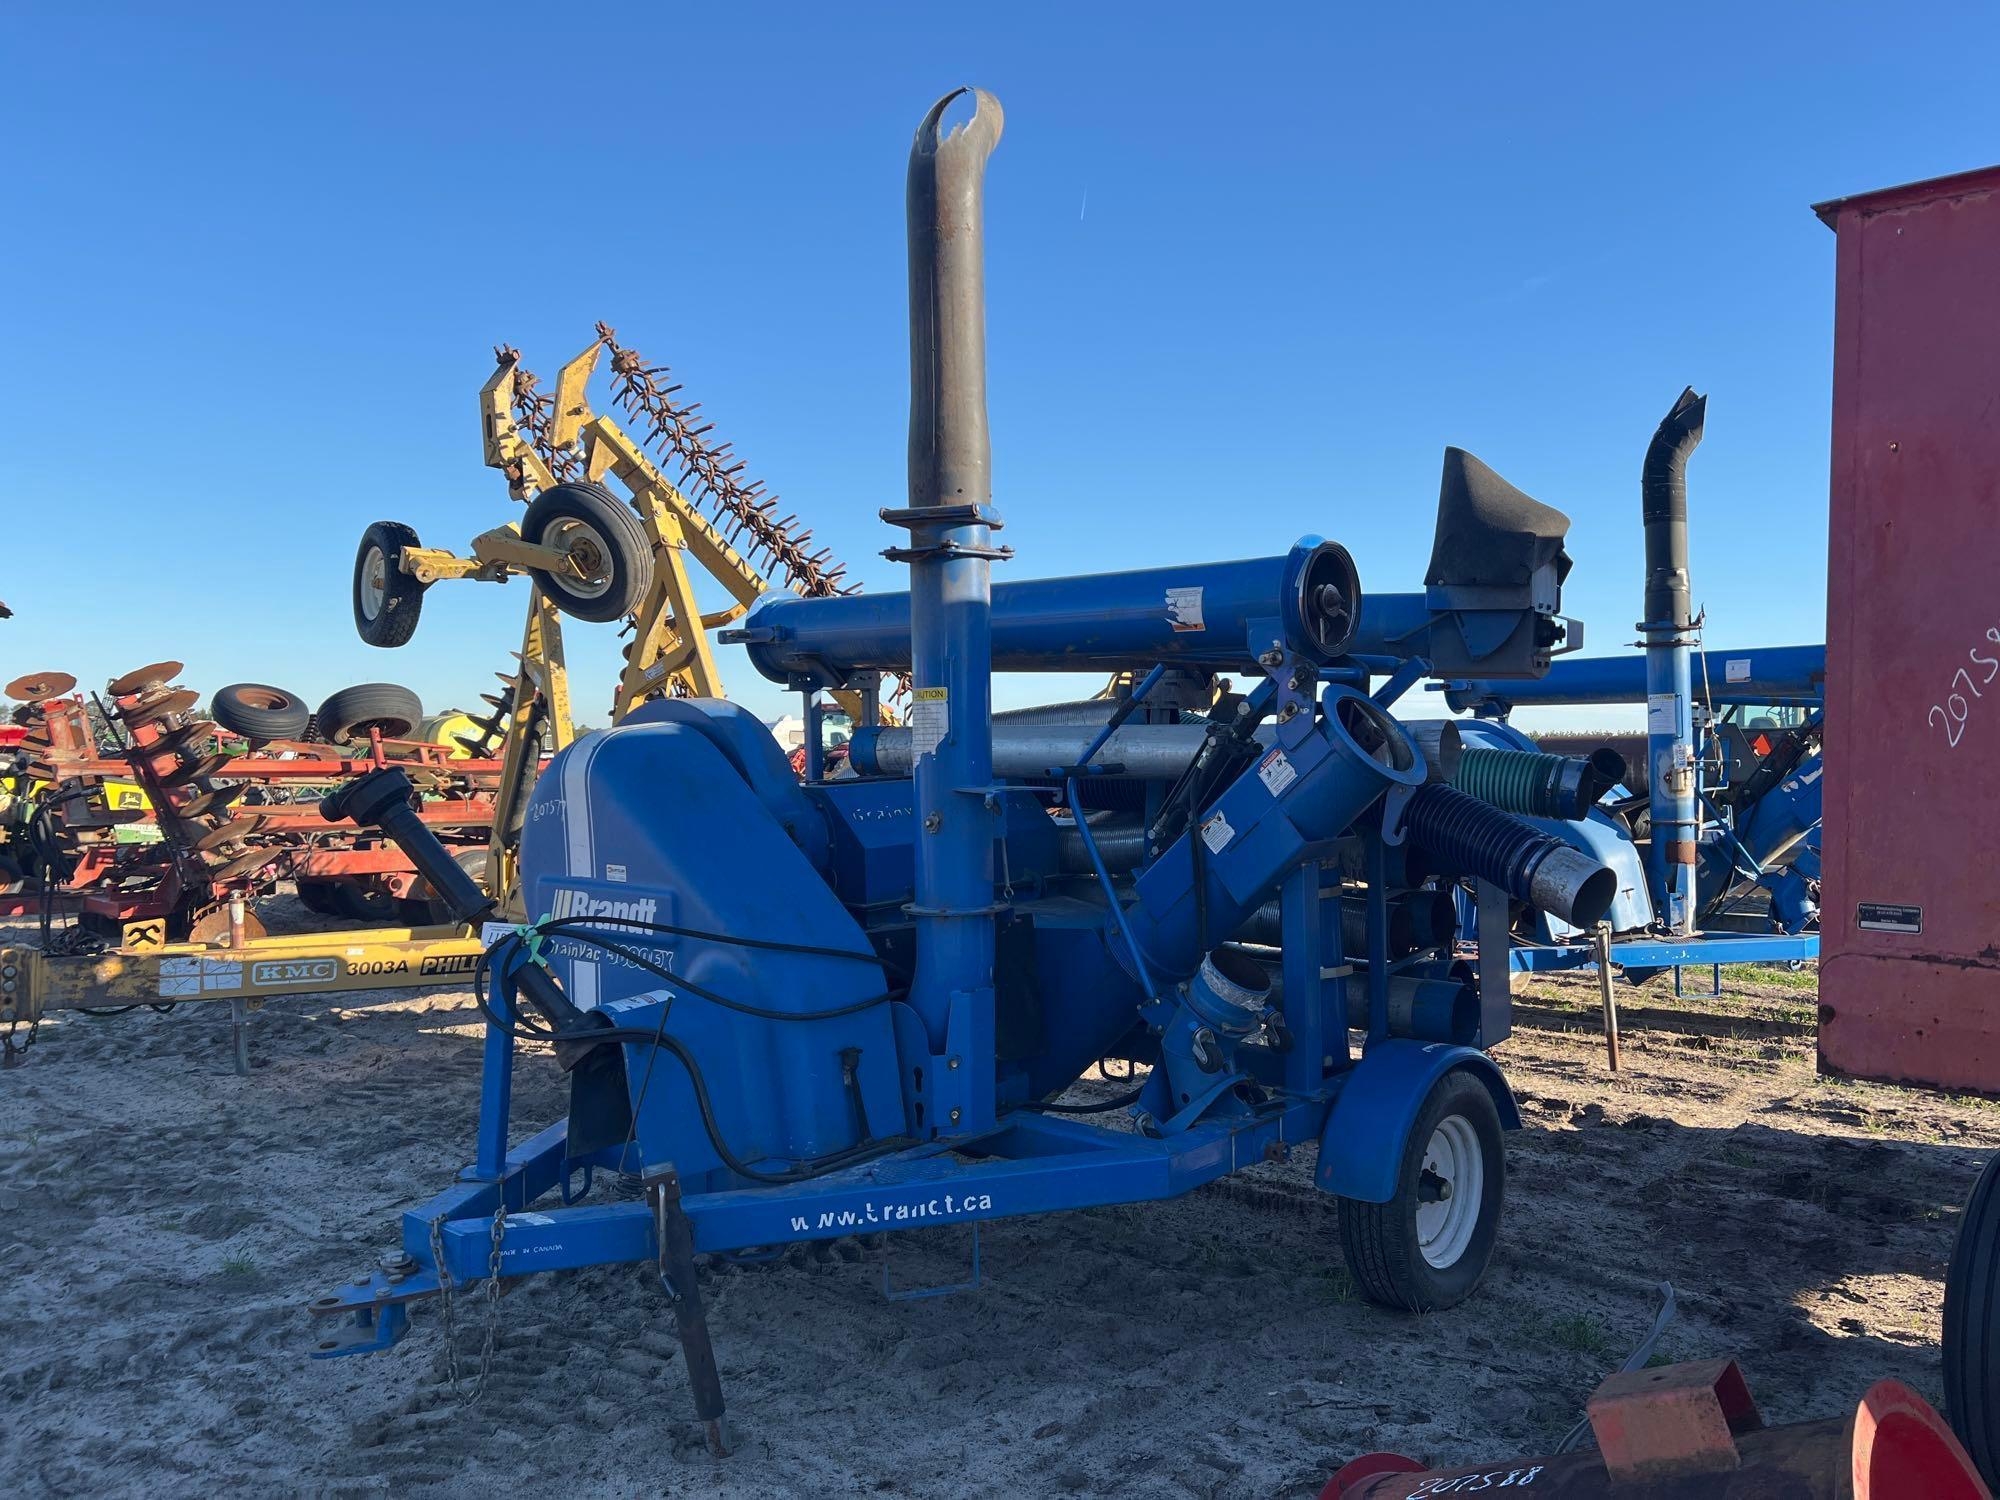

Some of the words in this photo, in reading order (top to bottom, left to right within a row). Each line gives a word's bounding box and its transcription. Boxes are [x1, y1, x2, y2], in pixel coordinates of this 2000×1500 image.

[568, 890, 657, 936] Brandt
[260, 964, 330, 980] KMC
[346, 960, 409, 976] 3003A
[422, 956, 481, 974] PHILL
